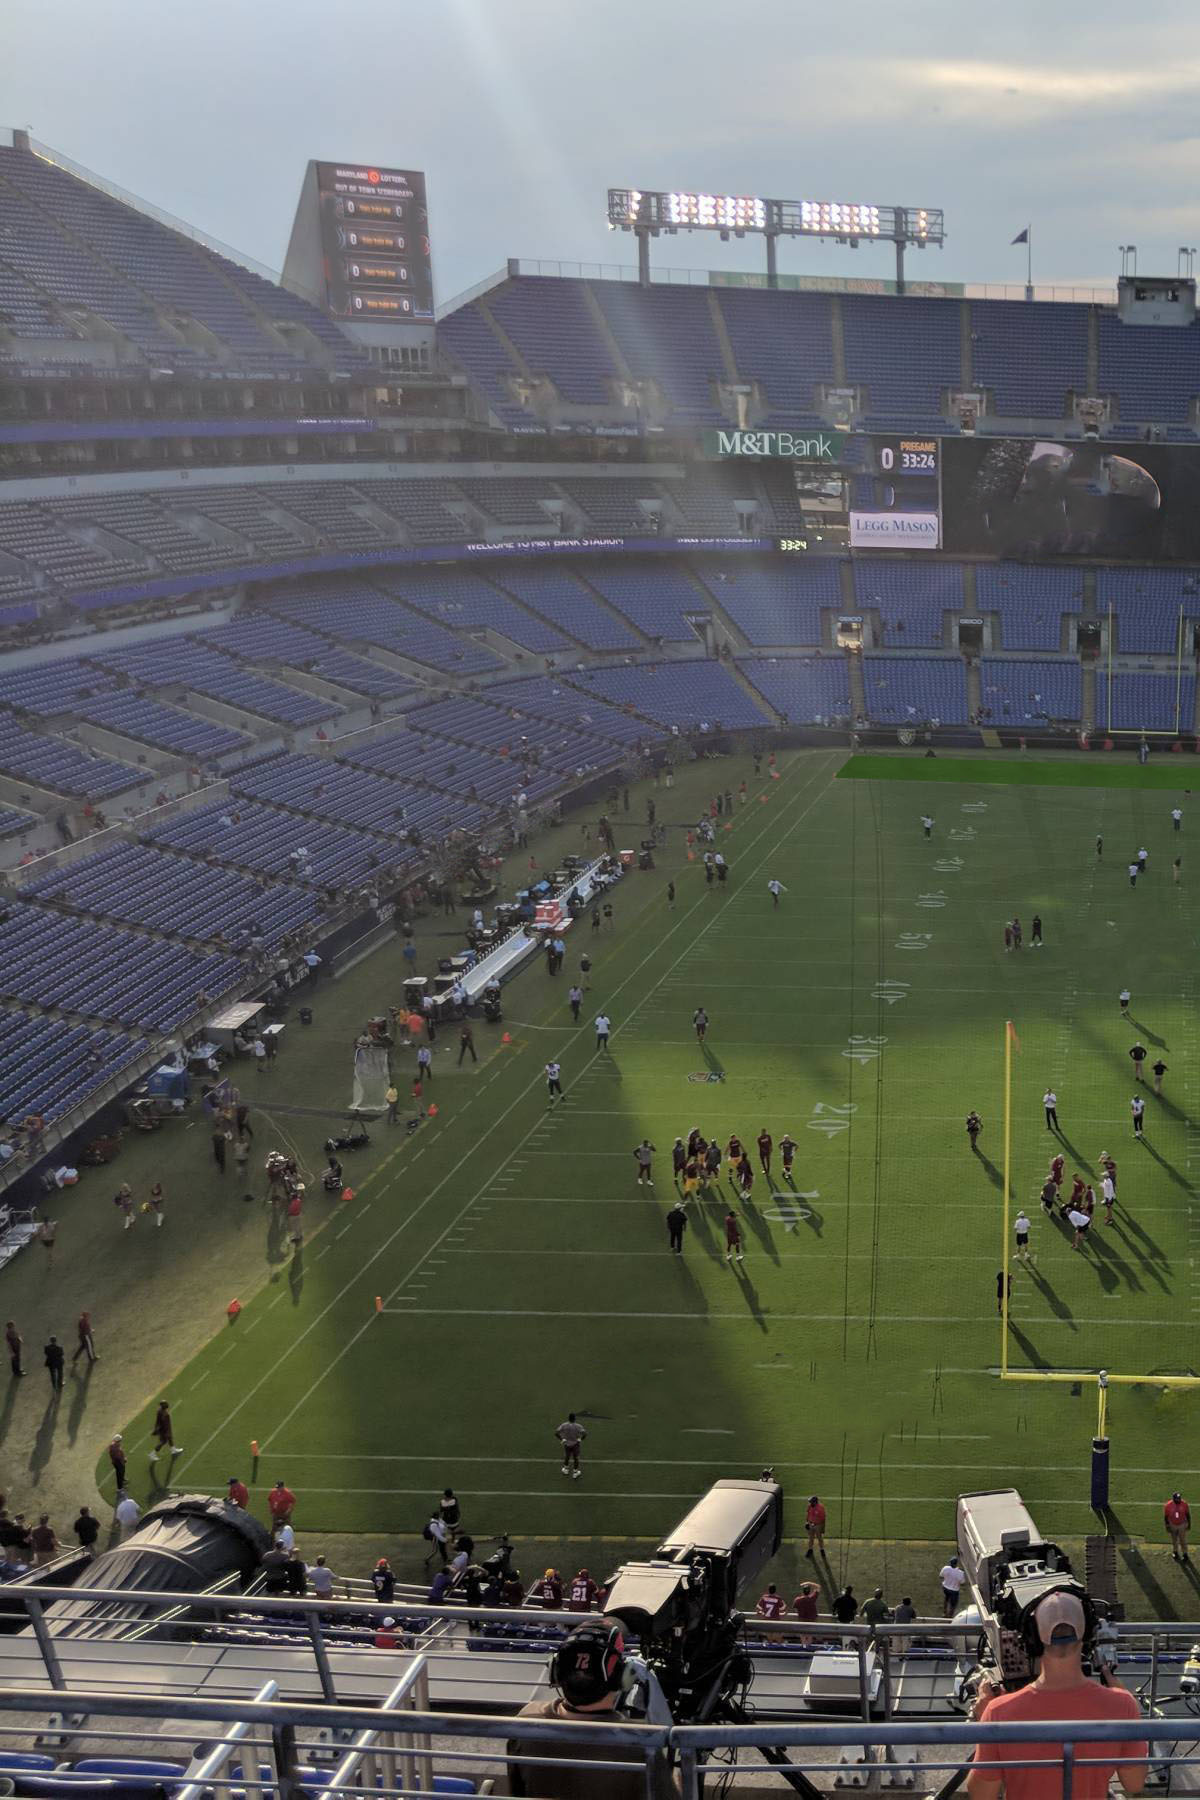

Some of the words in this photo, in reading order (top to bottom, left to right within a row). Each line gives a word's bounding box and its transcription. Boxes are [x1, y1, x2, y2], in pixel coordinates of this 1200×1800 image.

[348, 201, 355, 213] 0
[395, 206, 402, 217] 0
[398, 237, 405, 249] 0
[353, 265, 359, 277] 0
[400, 268, 407, 280] 0
[355, 297, 362, 309] 0
[403, 300, 410, 311] 0
[717, 431, 776, 455] M&T
[778, 433, 832, 457] Bank
[900, 441, 936, 452] PREGAME
[881, 448, 894, 470] 0
[902, 453, 935, 469] 33:24
[856, 518, 889, 532] LEGG
[892, 519, 936, 533] MASON
[780, 539, 807, 550] 33:24
[841, 1035, 889, 1058] 30
[806, 1102, 858, 1131] 20
[762, 1190, 820, 1221] 10
[543, 1588, 555, 1600] 21
[571, 1587, 588, 1601] 21
[764, 1603, 775, 1618] 7
[575, 1653, 591, 1669] 72
